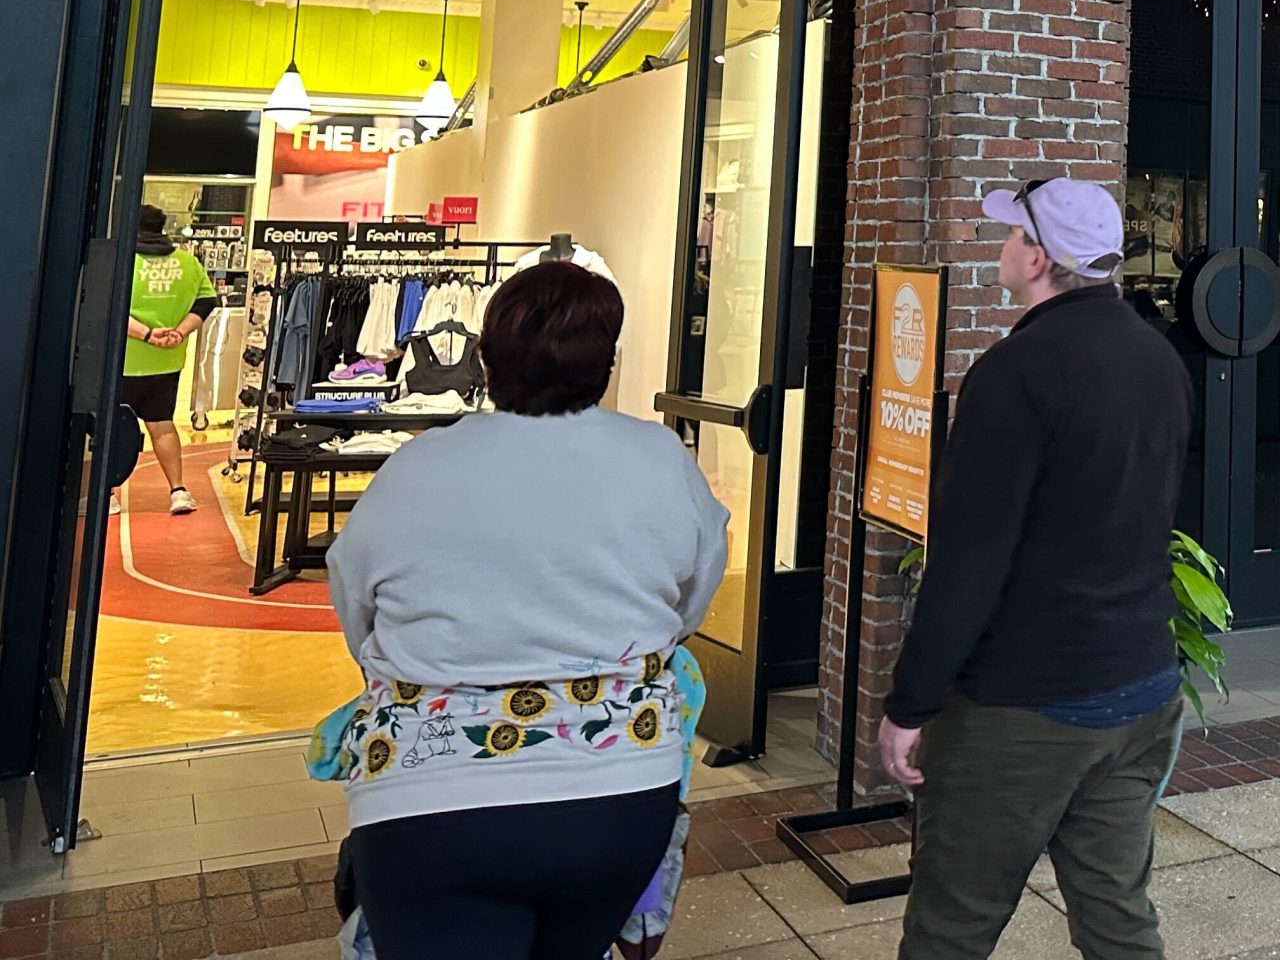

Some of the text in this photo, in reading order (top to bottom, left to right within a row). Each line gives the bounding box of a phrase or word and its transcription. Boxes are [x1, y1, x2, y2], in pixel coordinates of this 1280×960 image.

[291, 124, 354, 152] THE
[359, 126, 416, 153] BIG
[264, 227, 338, 243] feetures
[142, 257, 181, 269] FIND
[138, 269, 183, 280] YOUR
[148, 280, 174, 292] FIT
[893, 303, 924, 336] F2R
[892, 335, 924, 363] REWARDS
[880, 400, 931, 438] 10% OFF
